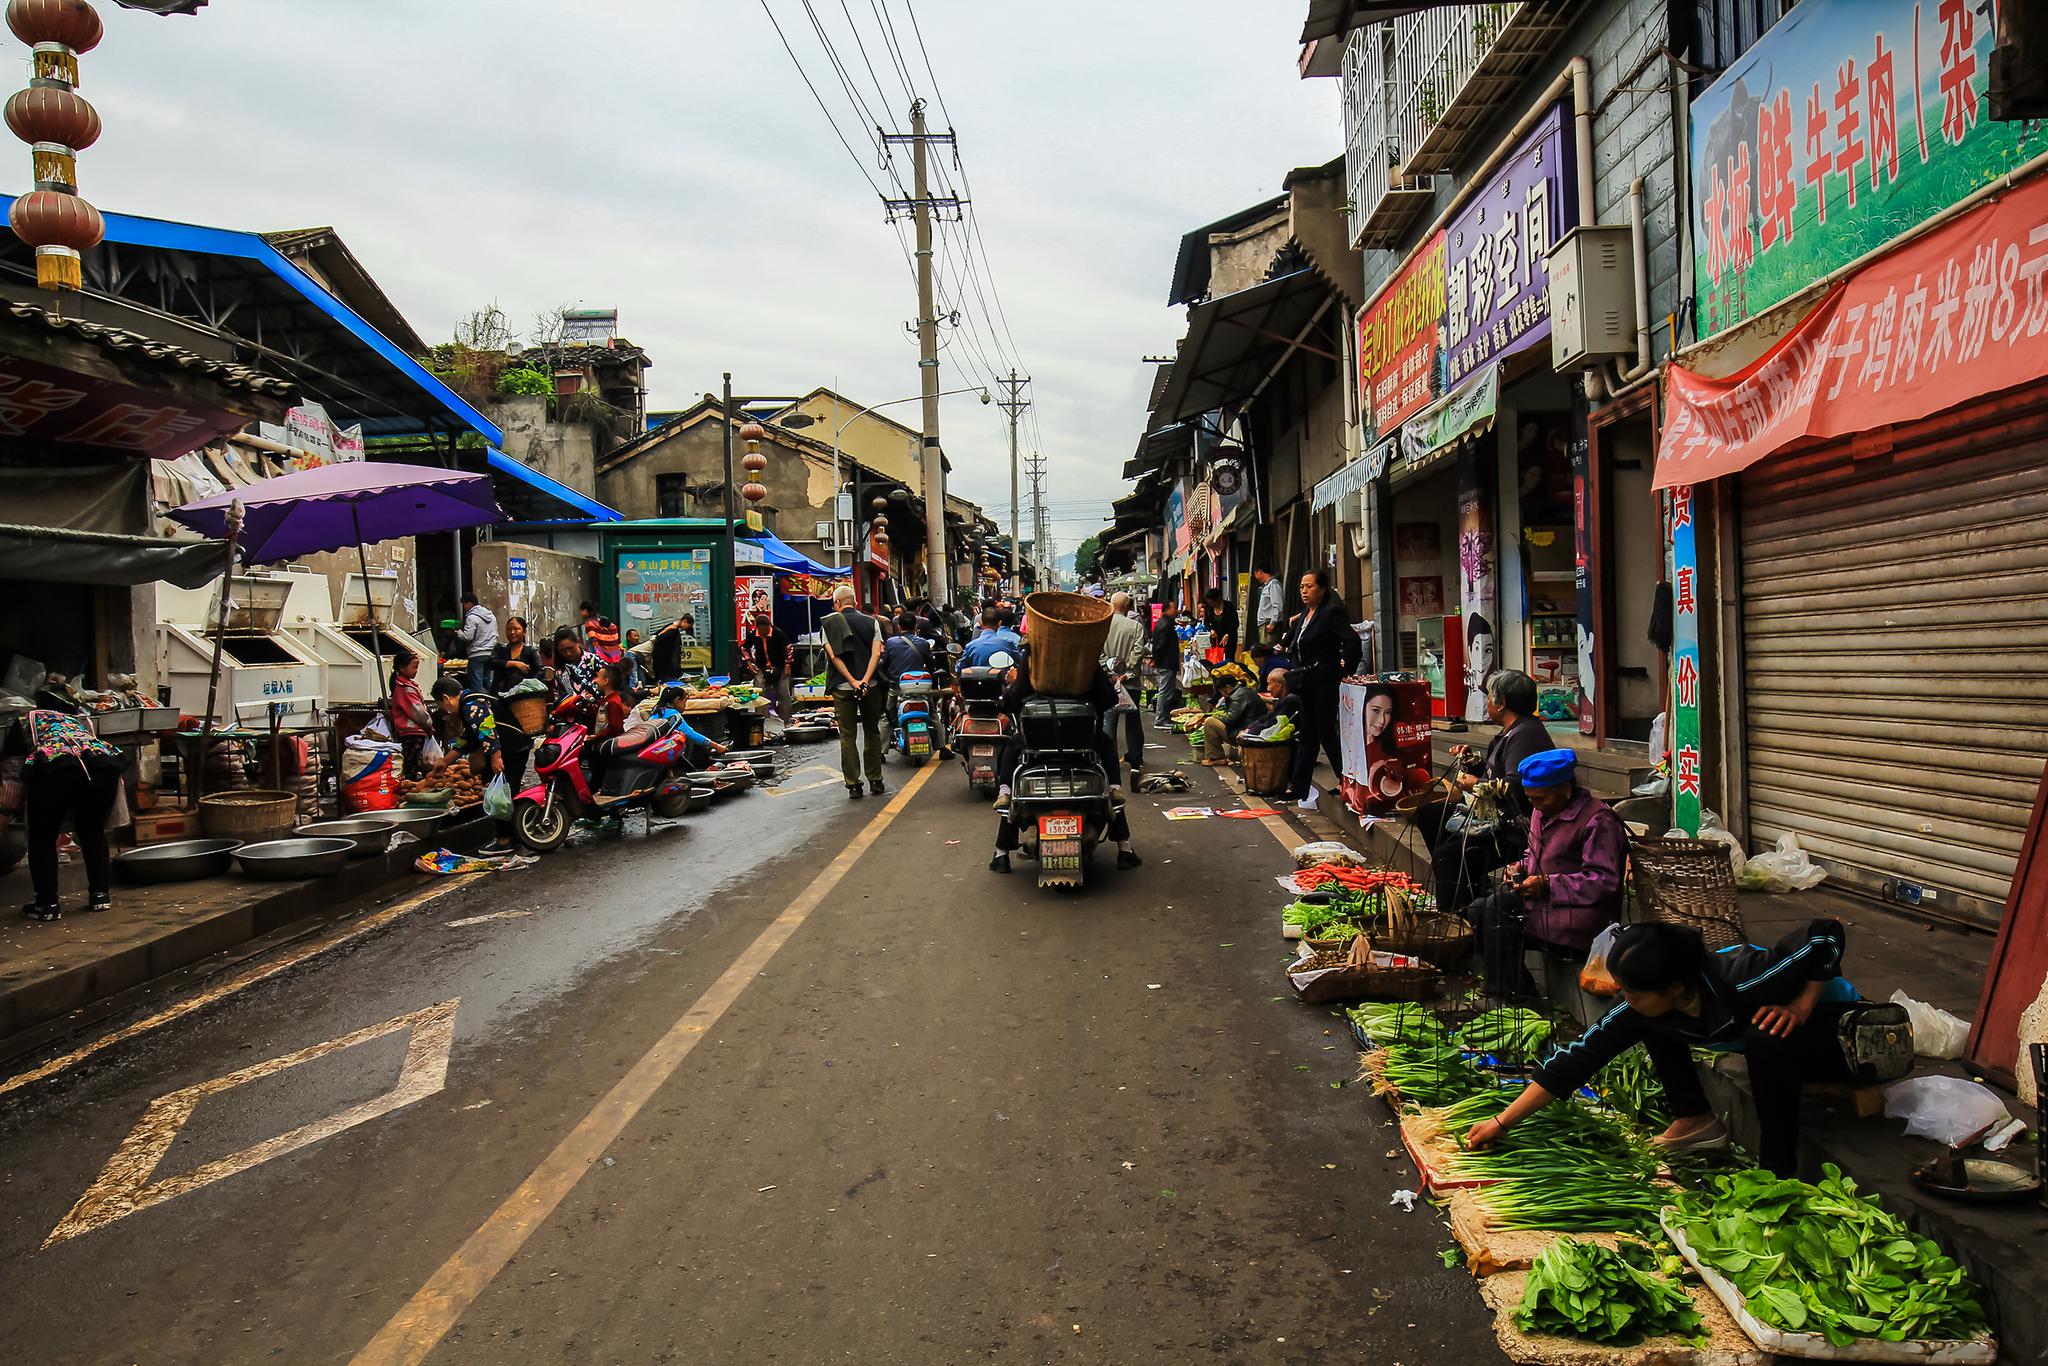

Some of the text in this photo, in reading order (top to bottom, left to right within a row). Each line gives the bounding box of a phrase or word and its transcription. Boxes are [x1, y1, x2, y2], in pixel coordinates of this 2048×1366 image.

[1363, 242, 1447, 379] 专业订做羽绒服
[1447, 176, 1550, 350] 靓彩空间
